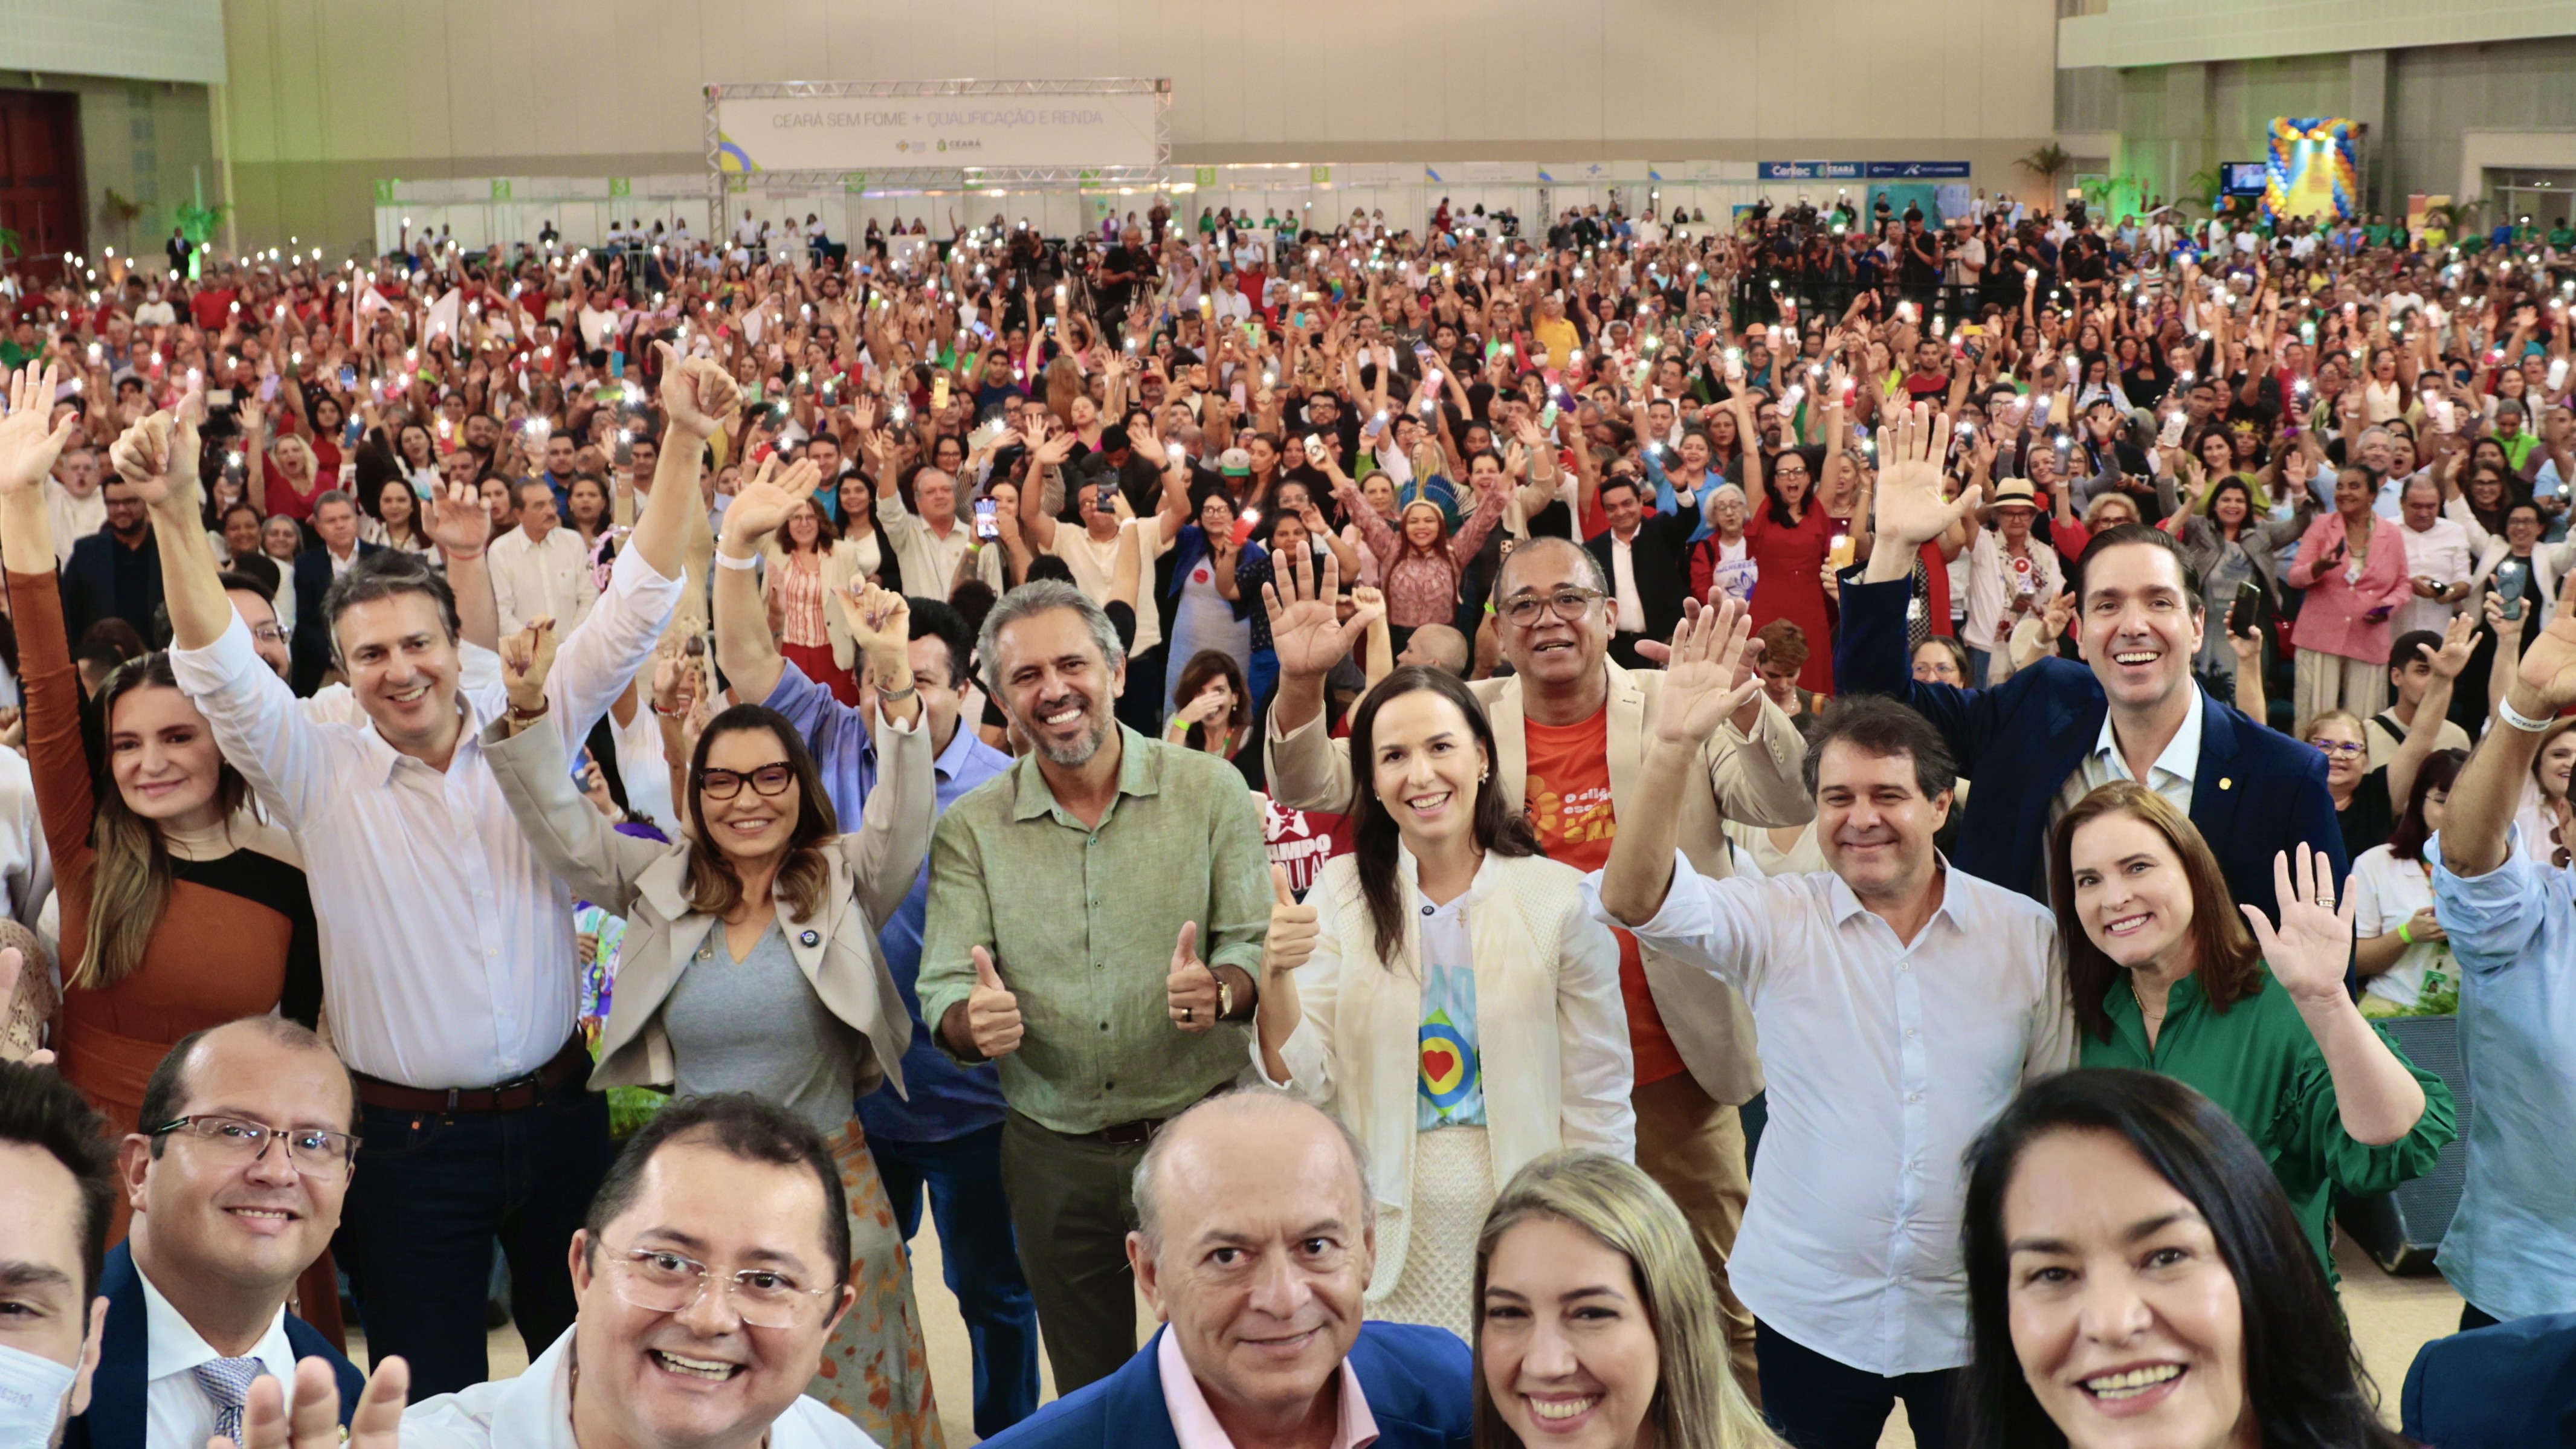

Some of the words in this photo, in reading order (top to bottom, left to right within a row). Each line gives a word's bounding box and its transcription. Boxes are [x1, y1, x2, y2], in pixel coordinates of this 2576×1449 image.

[773, 111, 823, 127] CEARÁ
[827, 112, 860, 127] SEM
[864, 112, 906, 126] FOME
[928, 109, 1035, 127] QUALIFICAÇÃO
[1039, 111, 1048, 124] E
[1052, 111, 1103, 124] RENDA
[1827, 164, 1855, 172] CEARÁ
[1564, 793, 1577, 804] O
[1265, 833, 1332, 862] AMPO
